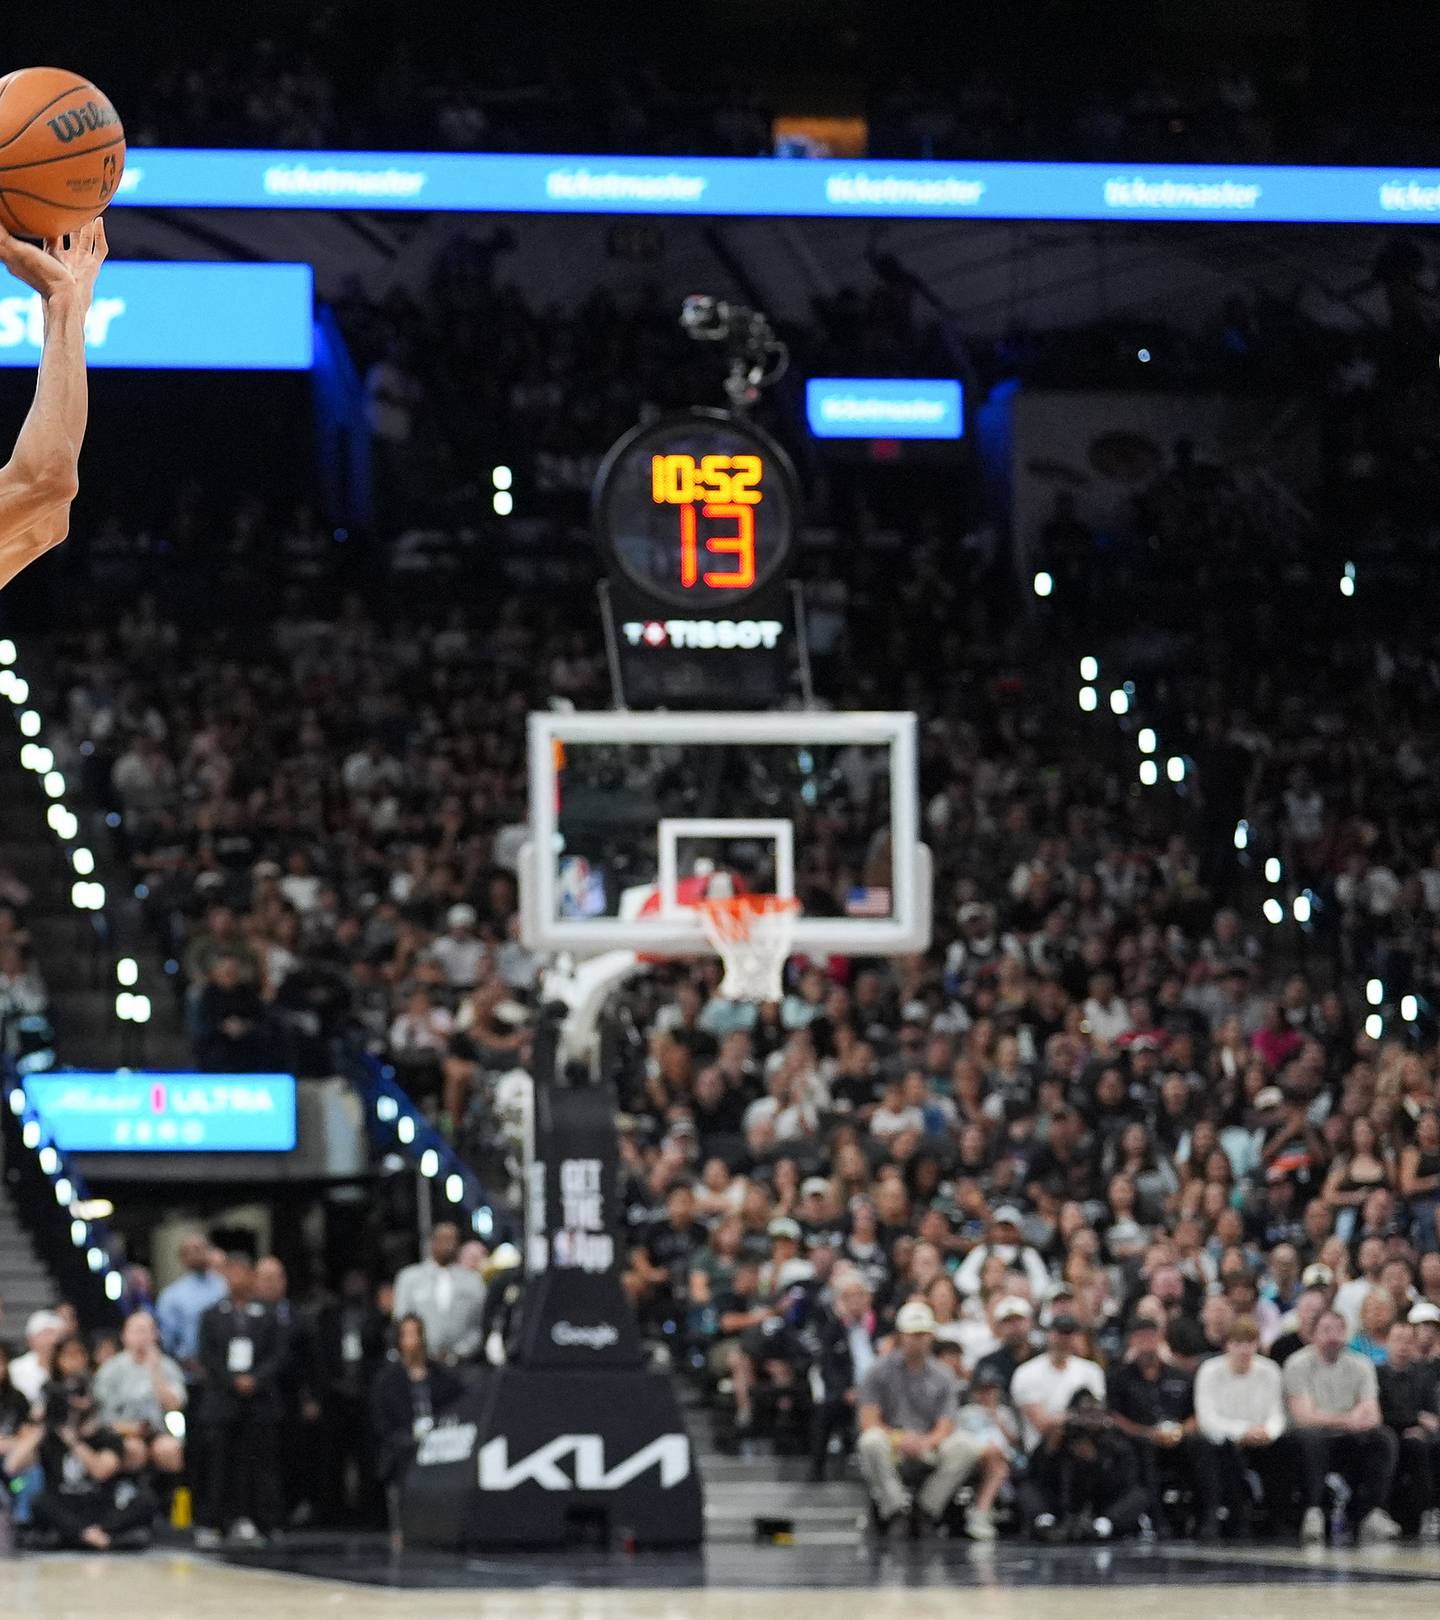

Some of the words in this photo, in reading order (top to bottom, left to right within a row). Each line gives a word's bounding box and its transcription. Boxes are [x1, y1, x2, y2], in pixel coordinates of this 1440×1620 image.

[47, 102, 121, 143] Wil
[263, 165, 425, 196] ticketmaster
[546, 170, 706, 200] ticketmaster
[826, 176, 984, 205] ticketmaster
[1104, 179, 1260, 209] ticketmaster
[1379, 180, 1440, 211] ticke
[651, 454, 762, 504] 10:52
[680, 503, 755, 588] 13
[665, 620, 782, 649] TISSOT
